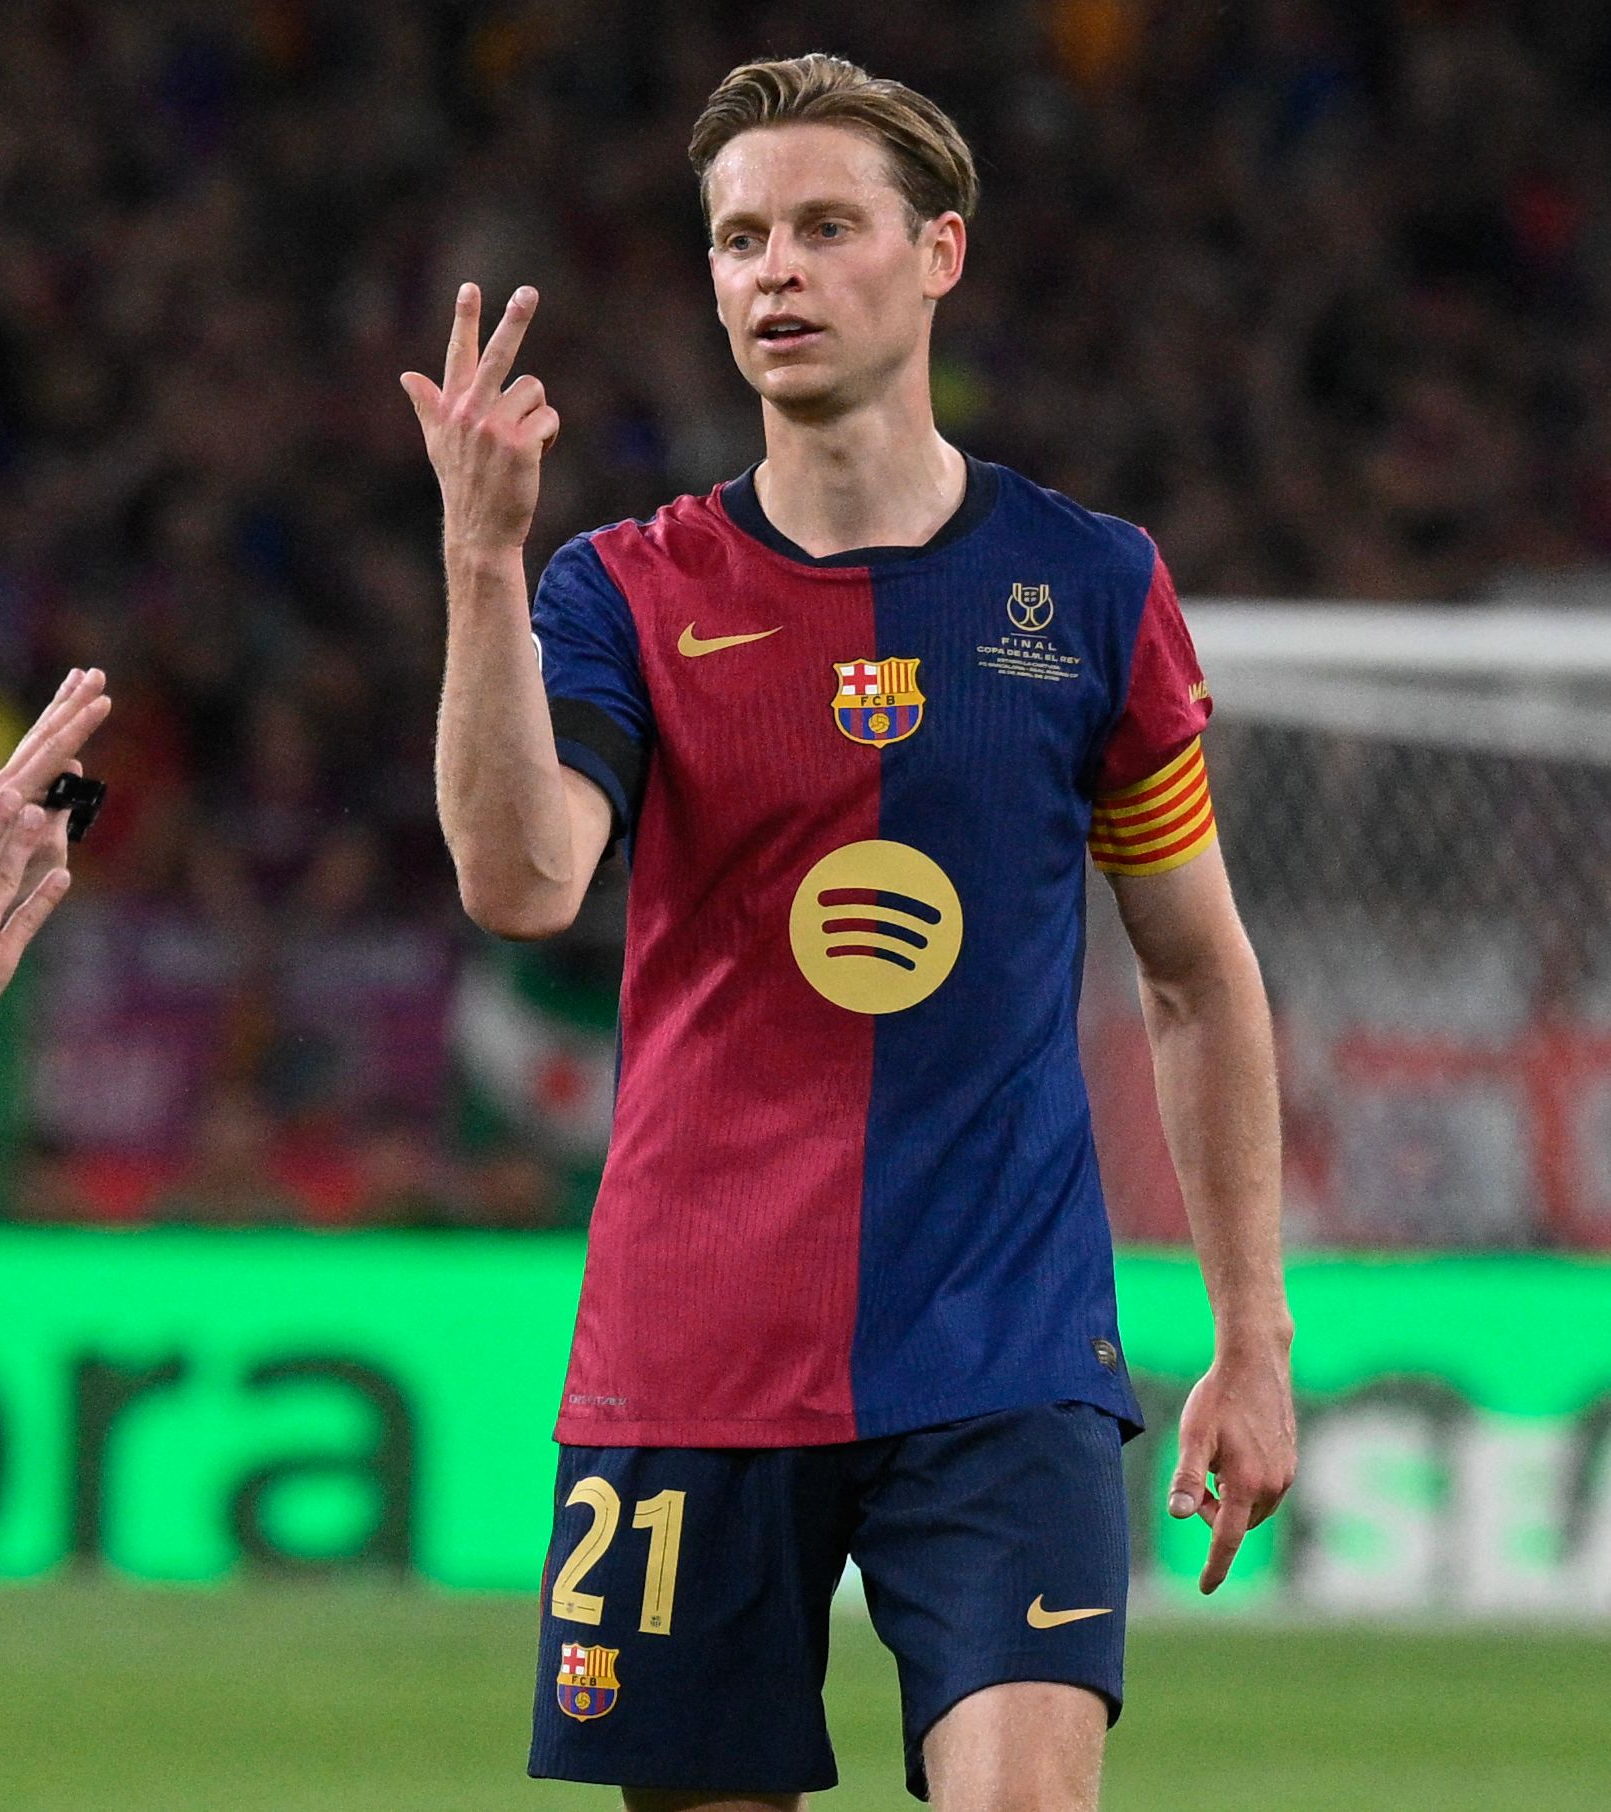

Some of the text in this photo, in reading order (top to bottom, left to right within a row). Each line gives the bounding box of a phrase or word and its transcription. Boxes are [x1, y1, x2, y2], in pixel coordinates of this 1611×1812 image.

[1001, 637, 1057, 651] FINAL
[976, 646, 1005, 654] COPA
[1006, 649, 1021, 657] DE
[1044, 654, 1058, 662] EL
[1060, 656, 1081, 664] REY
[550, 1475, 687, 1636] 21
